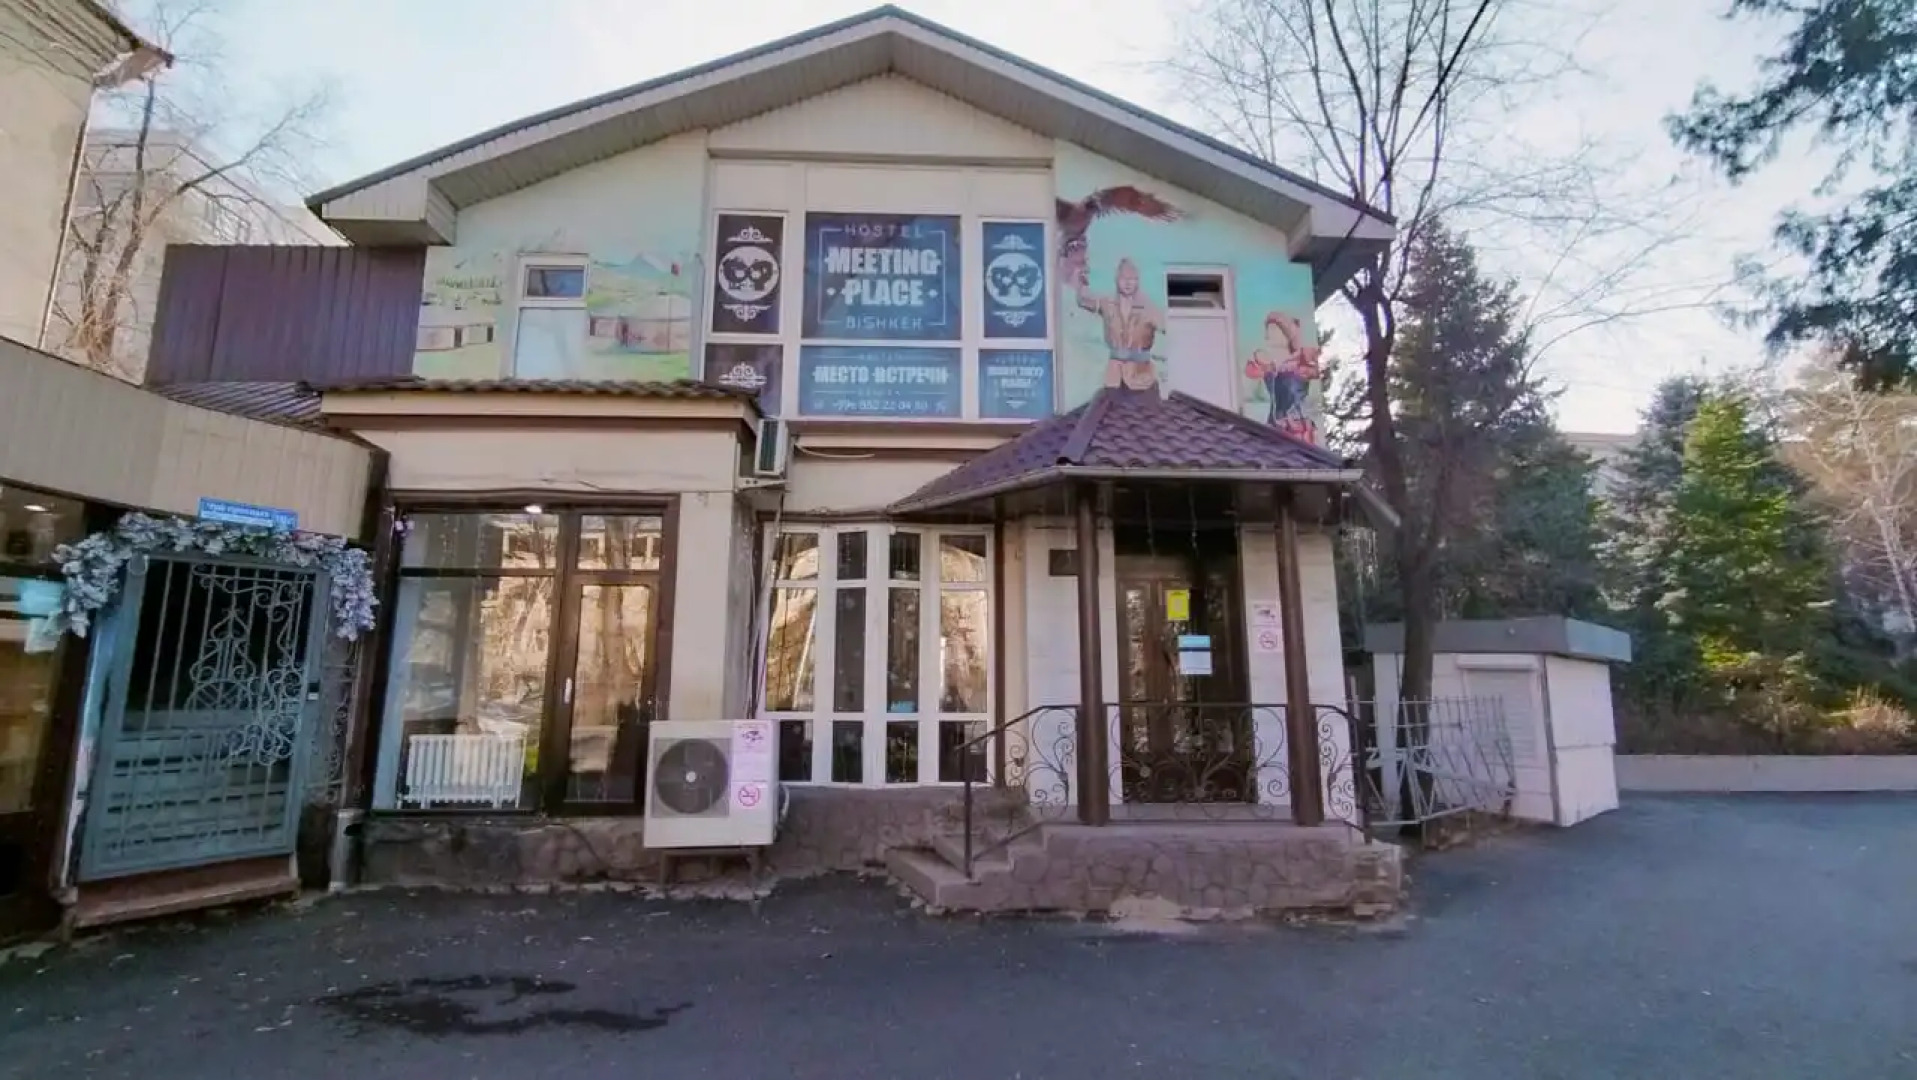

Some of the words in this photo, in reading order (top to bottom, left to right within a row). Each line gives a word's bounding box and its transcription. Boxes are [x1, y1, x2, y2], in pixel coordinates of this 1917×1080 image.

[844, 223, 923, 238] HOSTEL
[826, 246, 940, 275] MEETING
[842, 279, 924, 306] PLACE
[847, 315, 922, 330] BISHKEK
[813, 365, 869, 383] МЕСТО
